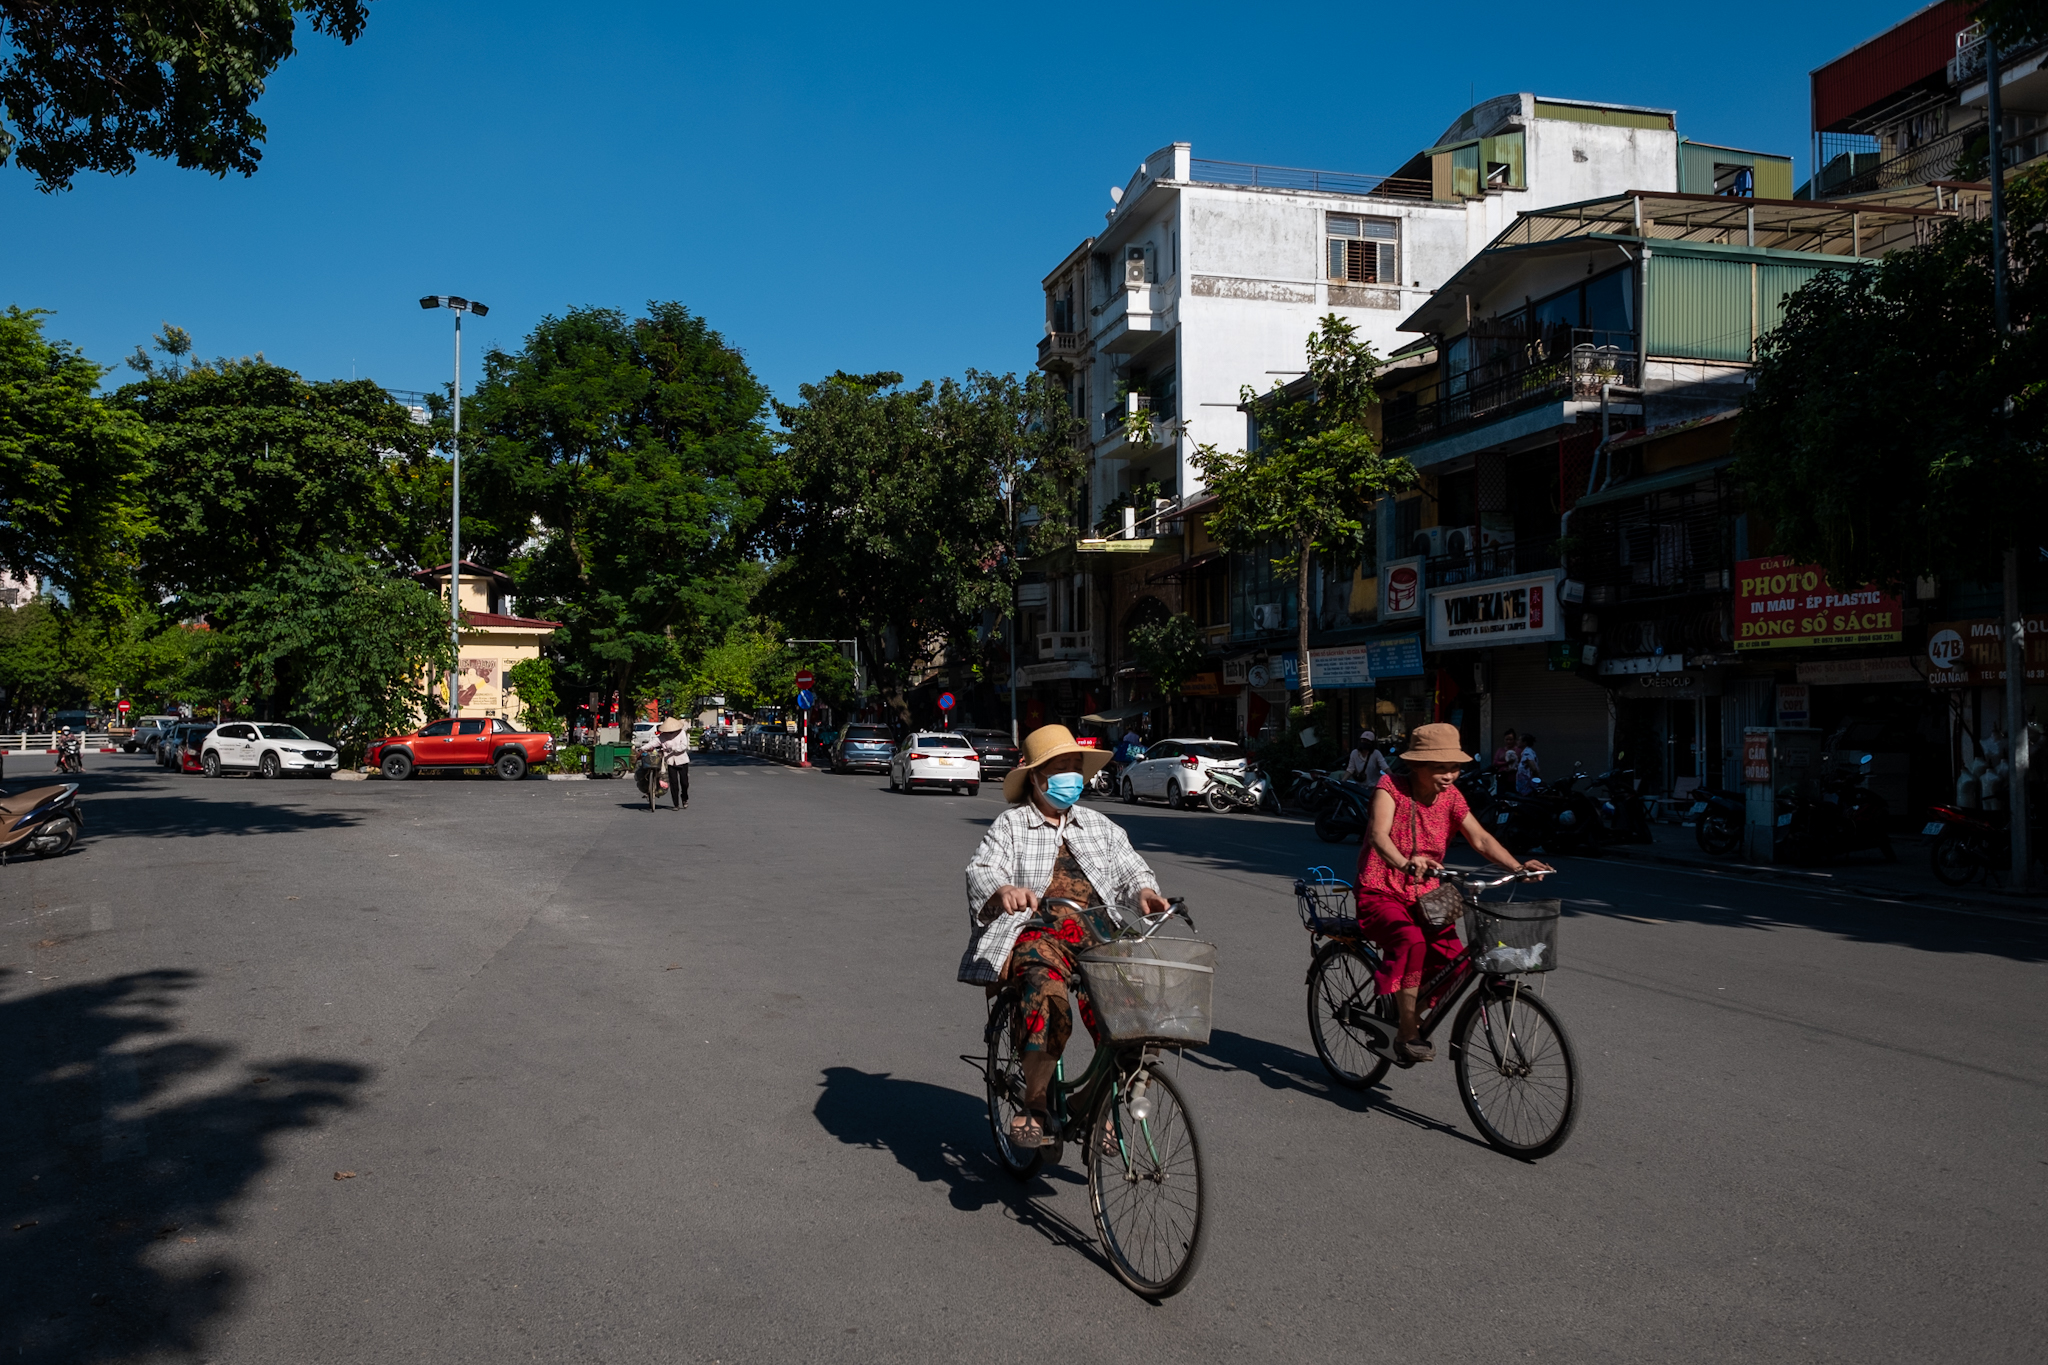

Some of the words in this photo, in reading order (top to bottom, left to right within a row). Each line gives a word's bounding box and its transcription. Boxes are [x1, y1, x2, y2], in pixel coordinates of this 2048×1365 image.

[1741, 571, 1818, 597] PHOTO
[1445, 589, 1526, 625] YONGKANG
[1751, 602, 1764, 613] IN
[1767, 598, 1795, 612] MÀU
[1806, 595, 1823, 609] ÉP
[1826, 591, 1881, 607] PLASTIC
[1741, 617, 1796, 637] ĐÓNG
[1801, 609, 1829, 633] SỔ
[1833, 610, 1893, 632] SÁCH
[1449, 628, 1472, 637] HOTPOT
[1932, 640, 1961, 658] 47B
[1561, 661, 1571, 669] 47
[1981, 671, 1996, 680] TEL:
[1780, 686, 1806, 697] PHOTO
[1783, 699, 1804, 710] COPY
[1748, 744, 1767, 760] CẤM
[1755, 763, 1769, 779] RÁC
